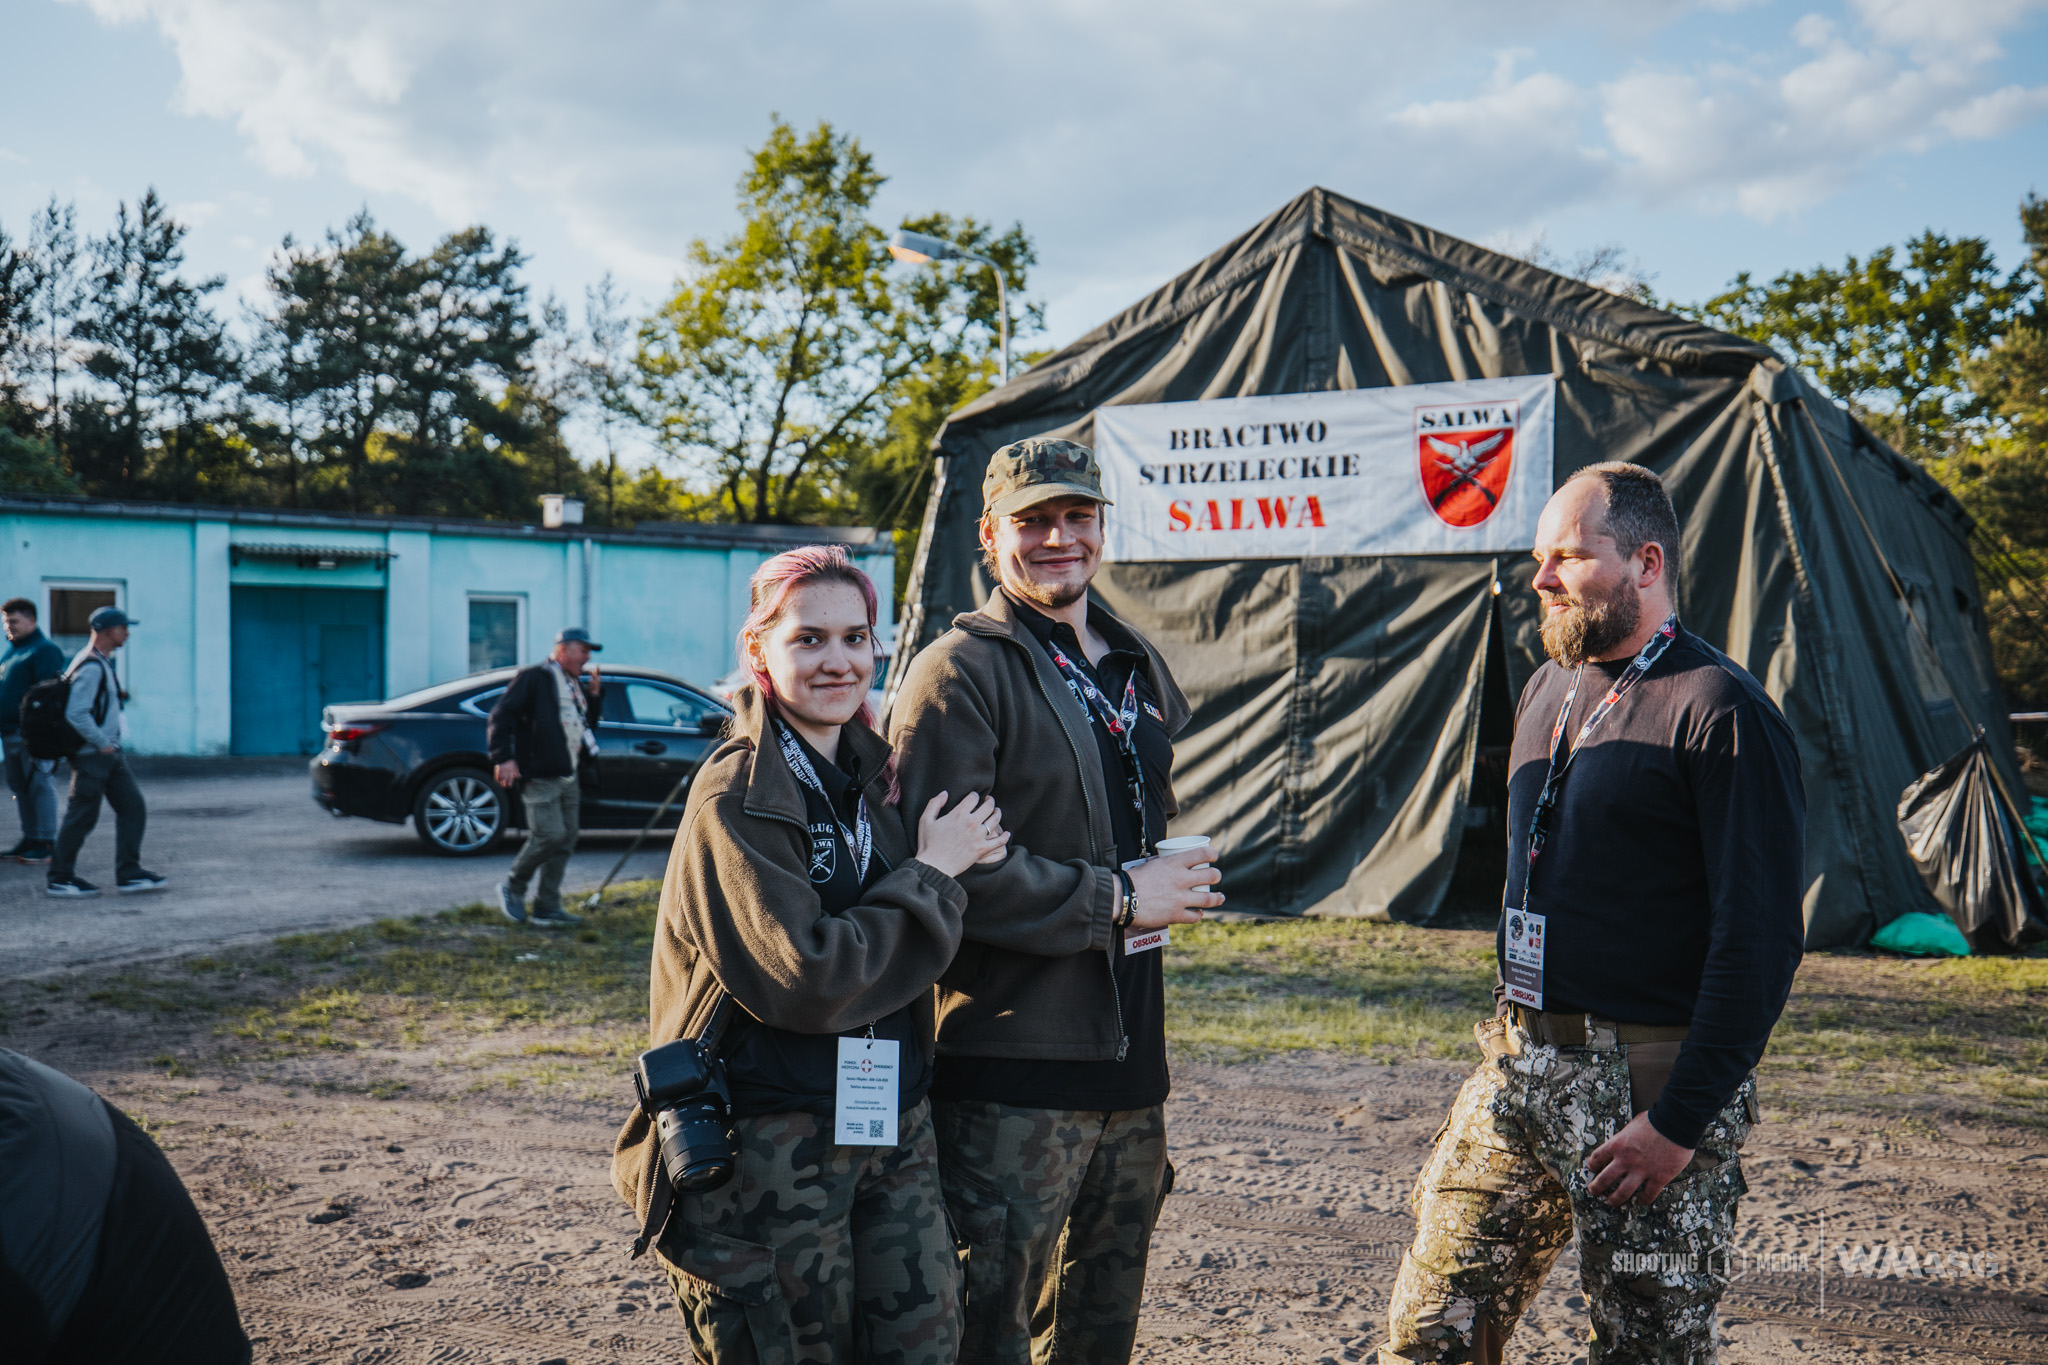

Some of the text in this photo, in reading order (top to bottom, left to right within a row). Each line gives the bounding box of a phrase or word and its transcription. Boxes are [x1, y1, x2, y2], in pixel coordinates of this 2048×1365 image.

[1420, 406, 1513, 429] SALWA
[1170, 420, 1327, 450] BRACTWO
[1139, 454, 1360, 485] STRZELECKIE
[1168, 495, 1326, 531] SALWA
[1132, 934, 1162, 949] OBSŁUGA
[1511, 988, 1536, 1003] OBSŁUGA
